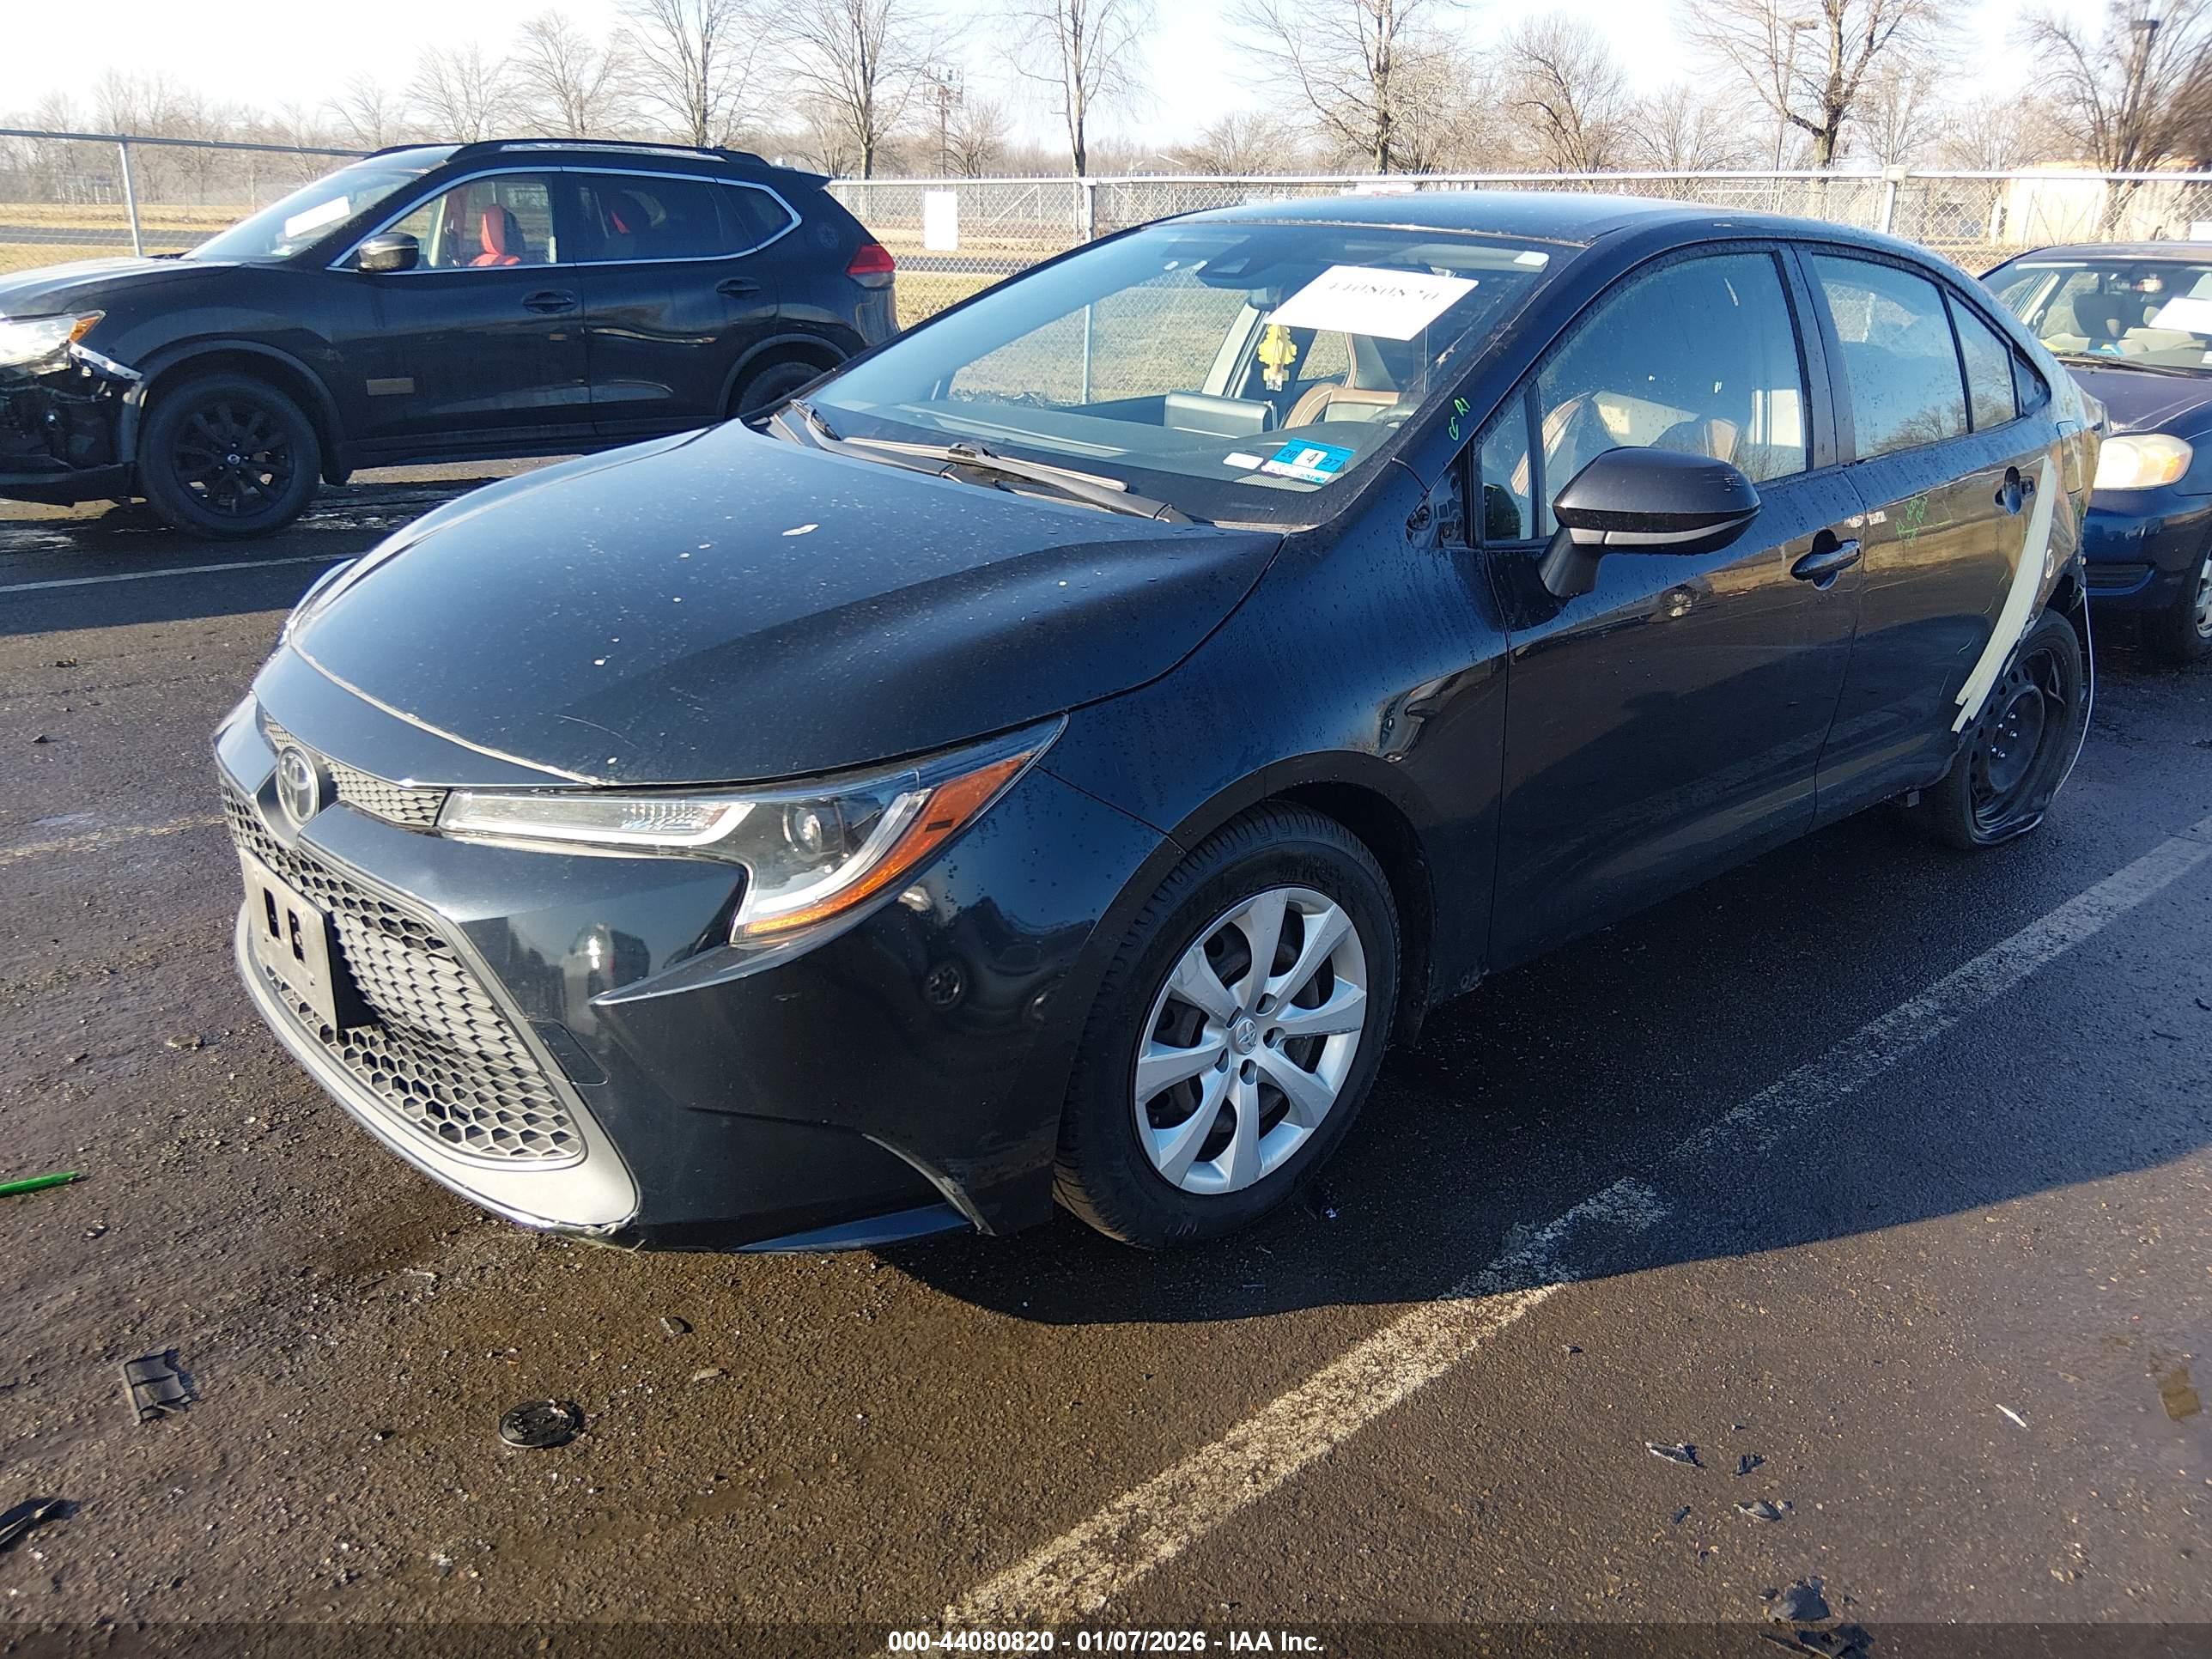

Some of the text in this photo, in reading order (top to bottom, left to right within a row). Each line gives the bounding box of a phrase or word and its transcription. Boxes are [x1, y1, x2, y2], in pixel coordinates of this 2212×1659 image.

[1282, 449, 1340, 467] 20 4 27
